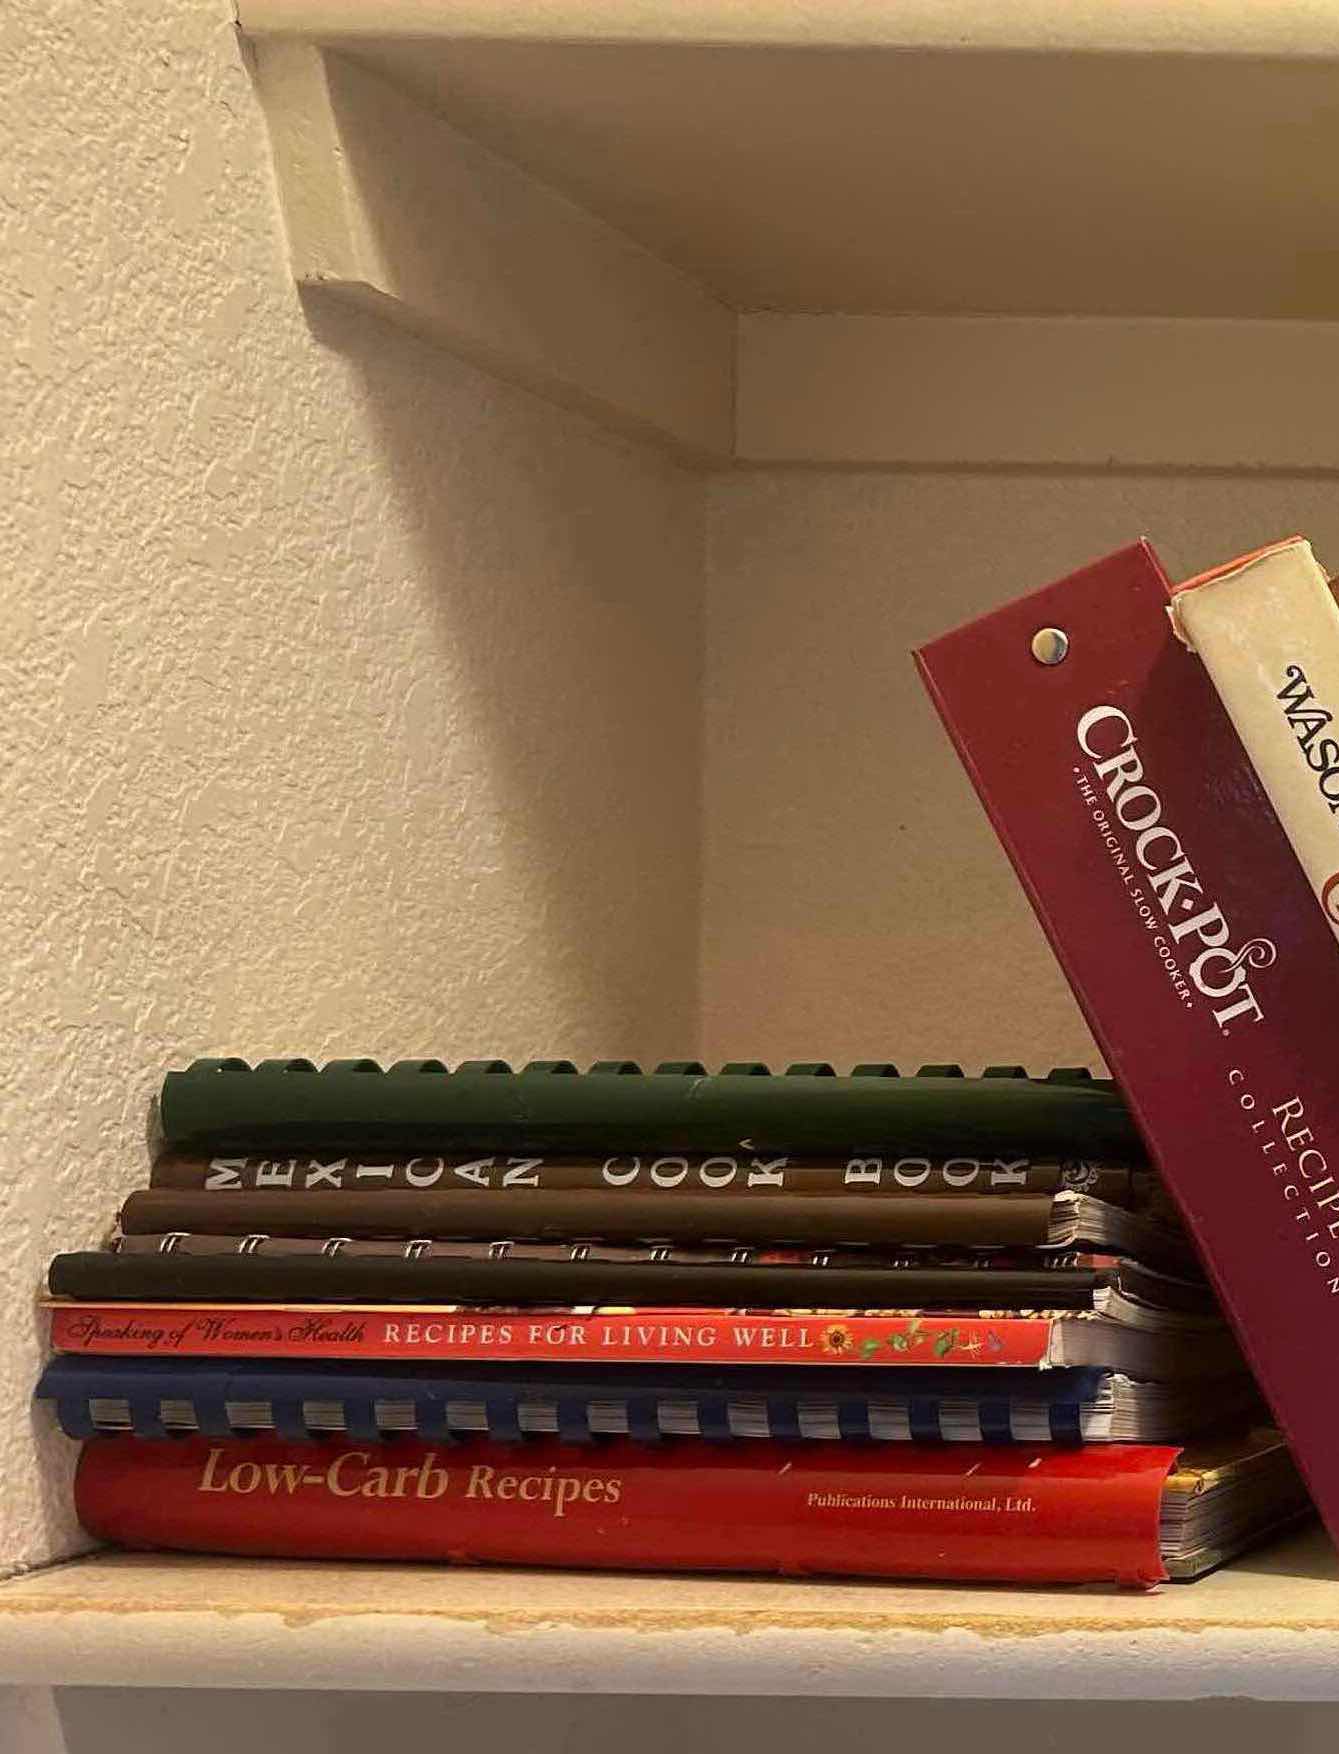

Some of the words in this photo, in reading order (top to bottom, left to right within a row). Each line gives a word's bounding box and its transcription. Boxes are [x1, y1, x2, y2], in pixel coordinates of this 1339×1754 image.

[1092, 809, 1134, 884] ORIGINAL
[1130, 888, 1159, 930] SLOW
[204, 1156, 544, 1191] MEXICAN
[602, 1156, 790, 1188] COOK
[844, 1156, 1031, 1187] BOOK
[66, 1316, 164, 1349] Speaking
[195, 1316, 284, 1344] Women's
[288, 1319, 366, 1344] Health
[384, 1323, 513, 1344] RECIPES
[528, 1324, 587, 1344] FOR
[601, 1325, 717, 1348] LIVING
[732, 1327, 814, 1349] WELL
[198, 1448, 449, 1498] Low-Carb
[464, 1464, 623, 1517] Recipes
[807, 1492, 896, 1511] Publications
